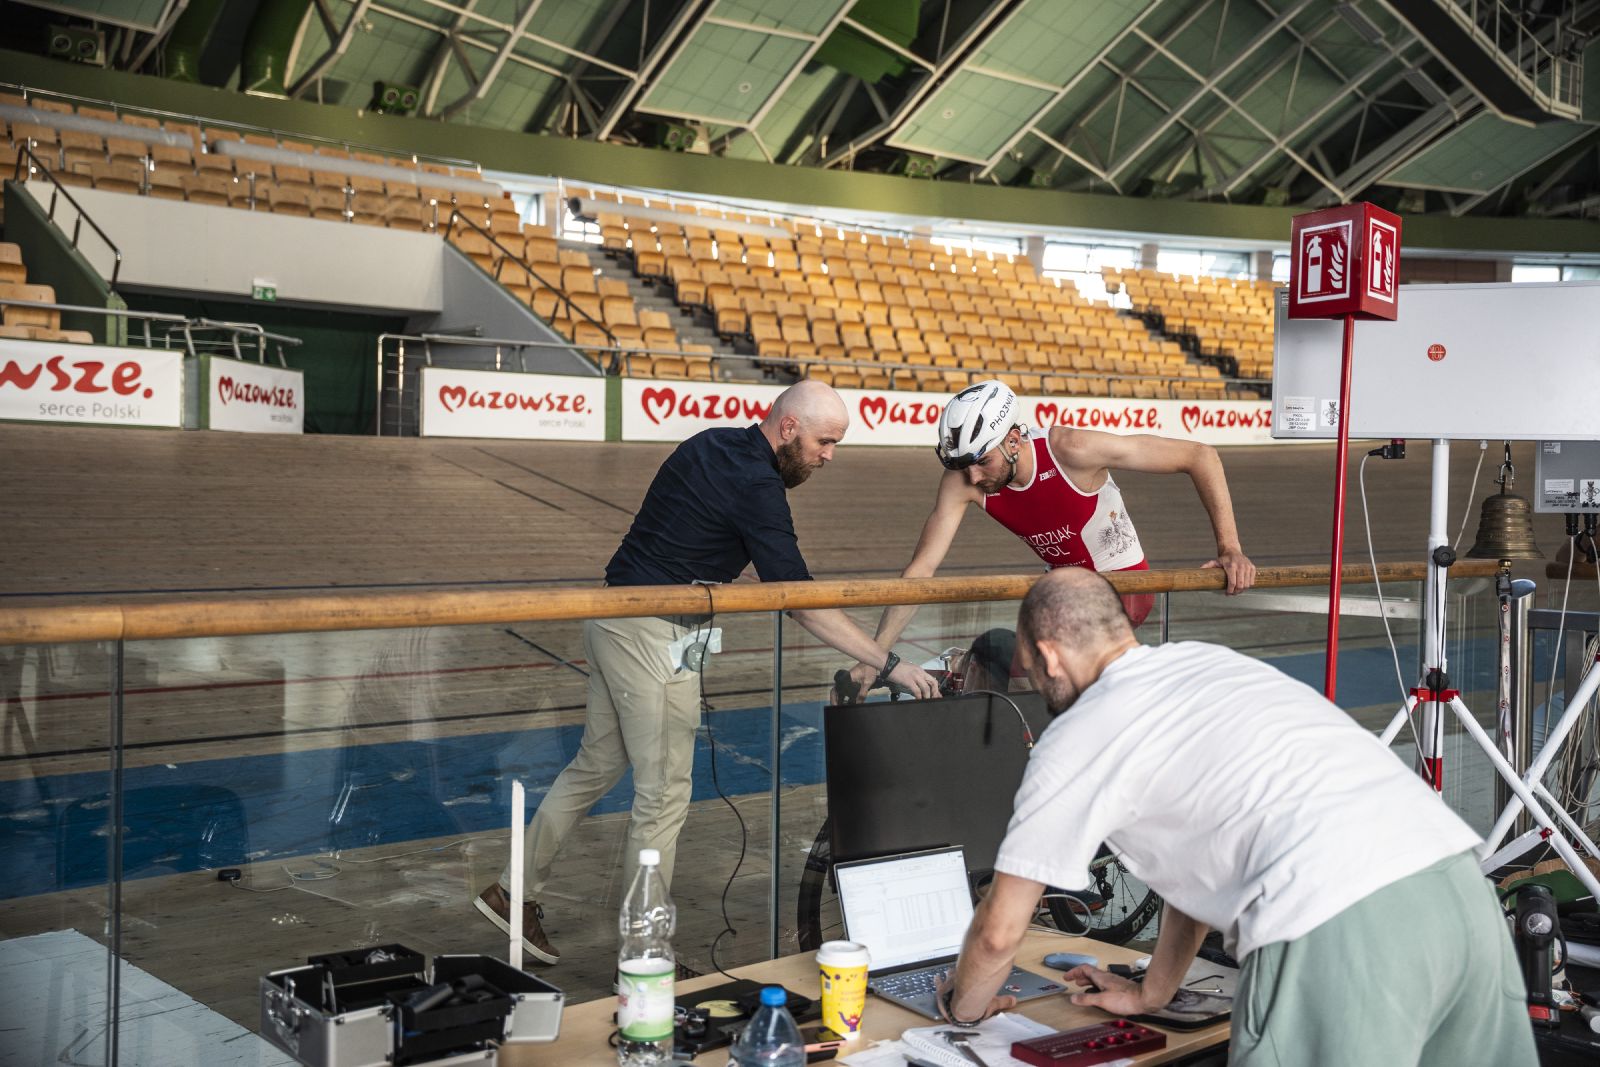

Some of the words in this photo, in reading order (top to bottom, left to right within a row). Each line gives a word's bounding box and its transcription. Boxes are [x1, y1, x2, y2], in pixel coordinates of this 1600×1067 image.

[218, 375, 296, 409] Mazowsze.
[438, 385, 592, 414] Mazowsze.
[39, 402, 86, 417] serce
[92, 402, 141, 419] Polski
[859, 396, 944, 431] Mazo
[1035, 402, 1162, 429] Mazowsze.
[1036, 545, 1070, 557] POL
[1132, 911, 1145, 932] DT
